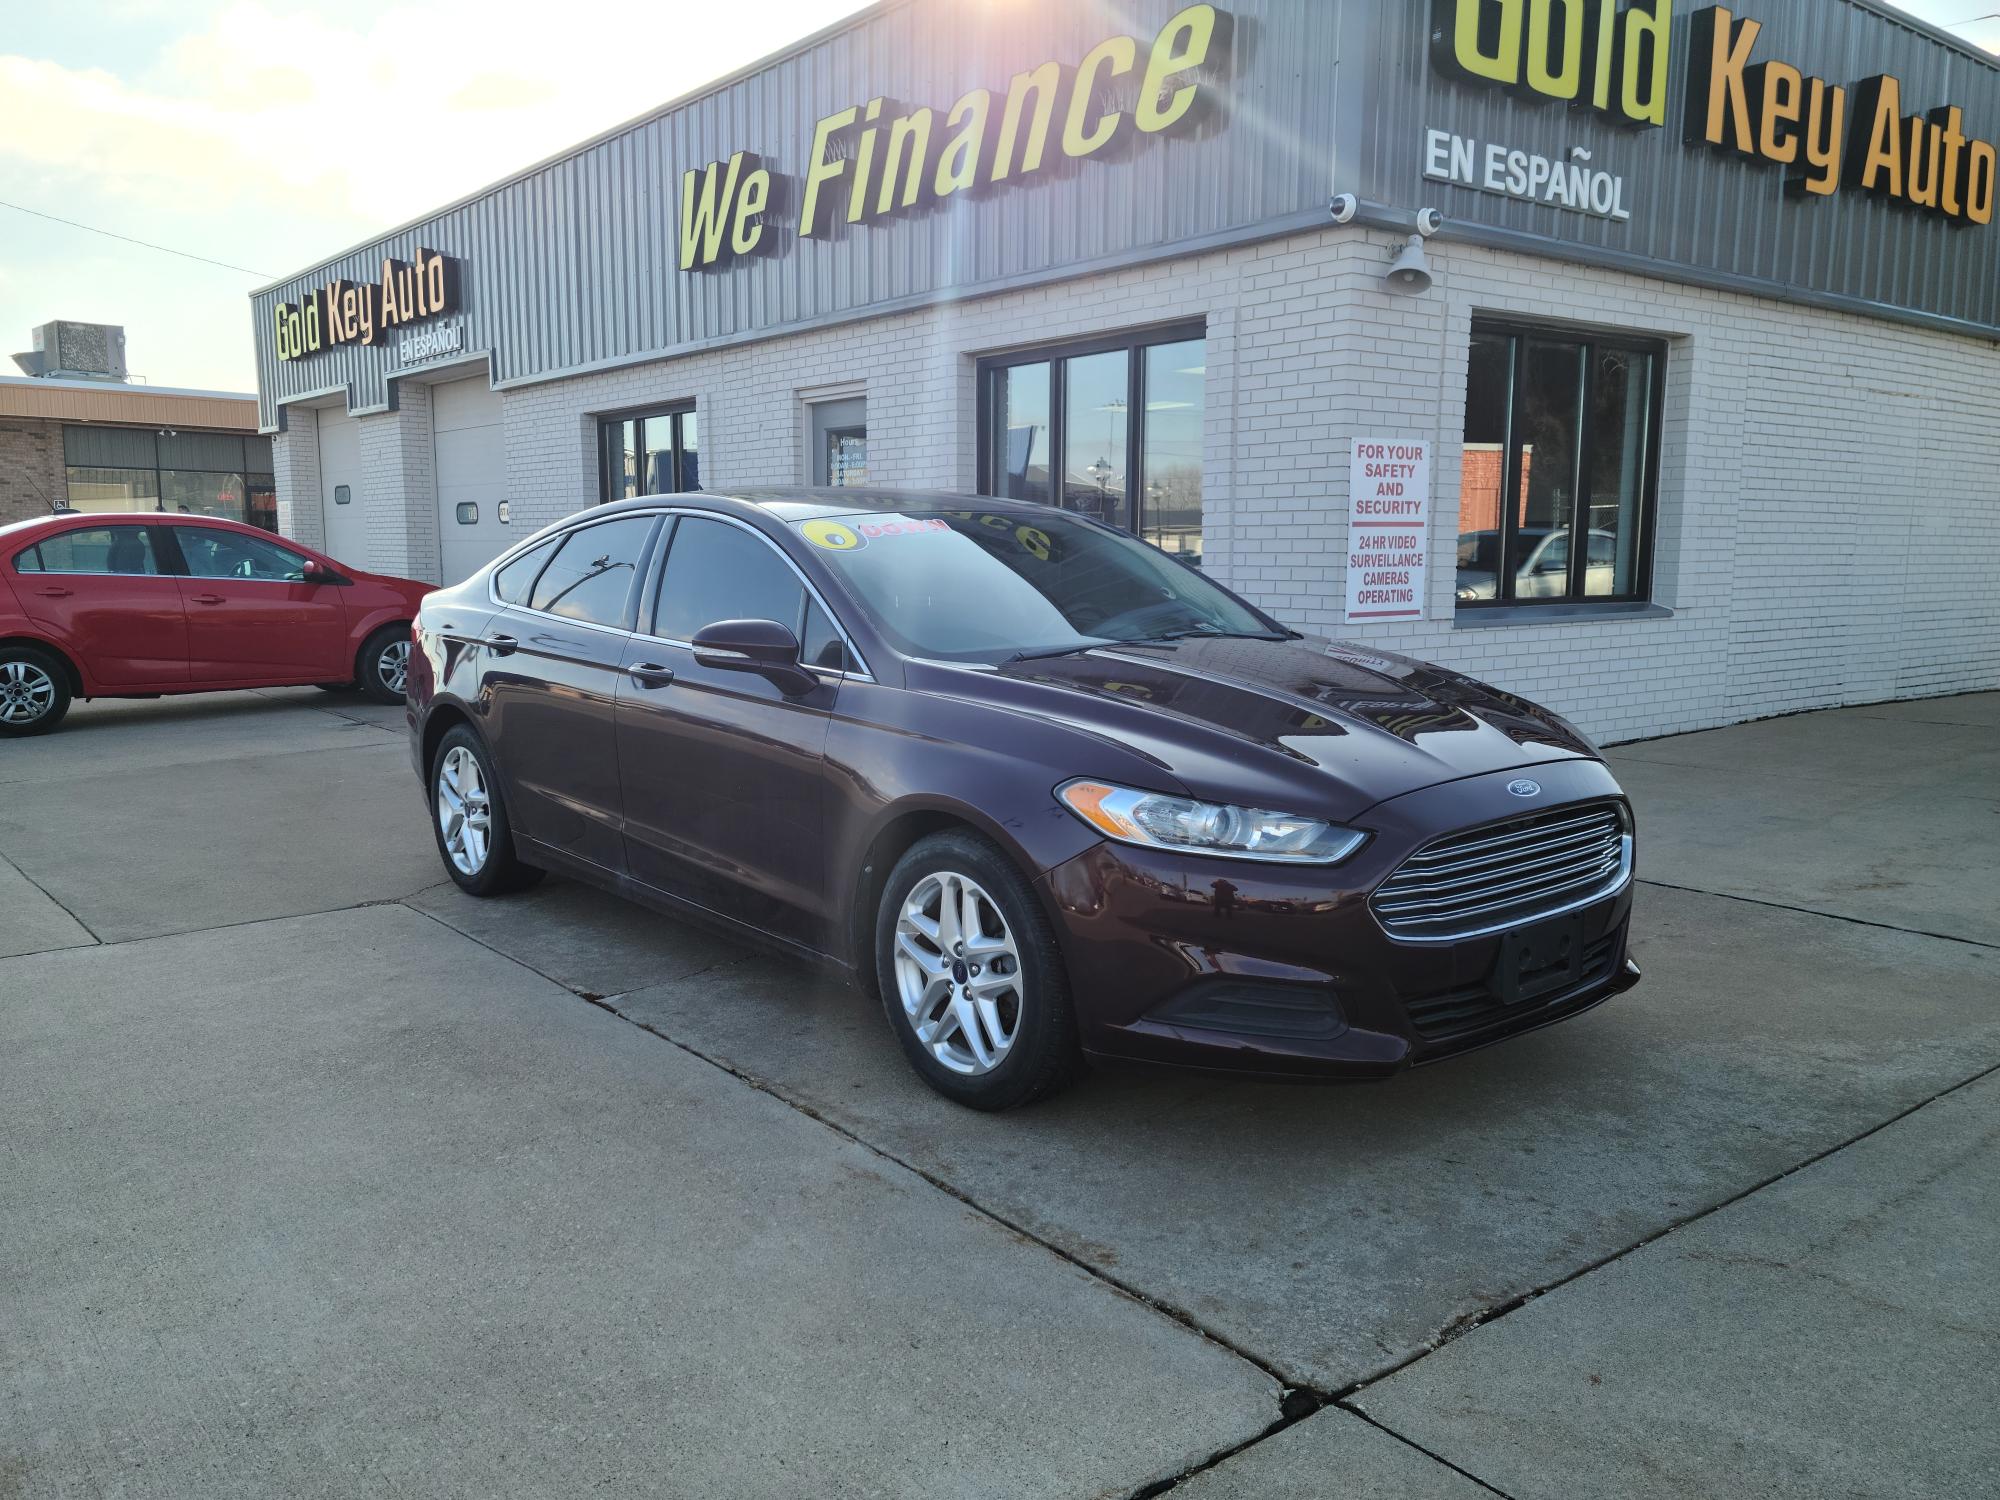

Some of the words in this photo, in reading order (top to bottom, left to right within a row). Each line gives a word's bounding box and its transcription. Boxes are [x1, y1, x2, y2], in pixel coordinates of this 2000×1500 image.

[1706, 4, 1846, 197] Key
[1861, 73, 1998, 226] Auto
[680, 150, 770, 272] We
[798, 3, 1217, 239] Finance
[1425, 128, 1475, 185] EN
[1483, 143, 1630, 220] ESPAÑOL
[274, 288, 321, 362] Gold
[326, 279, 374, 346] Key
[381, 246, 445, 328] Auto
[400, 339, 413, 361] EN
[414, 320, 462, 357] ESPAÑOL
[1357, 444, 1384, 460] FOR
[1387, 445, 1423, 461] YOUR
[1365, 463, 1415, 478] SAFETY
[1376, 482, 1404, 496] AND
[1356, 500, 1421, 515] SECURITY
[1359, 535, 1371, 550] 24
[1372, 535, 1386, 550] HR
[1388, 535, 1417, 550] VIDEO
[1350, 553, 1424, 569] SURVEILLANCE
[1363, 571, 1410, 586] CAMERAS
[1358, 588, 1414, 604] OPERATING
